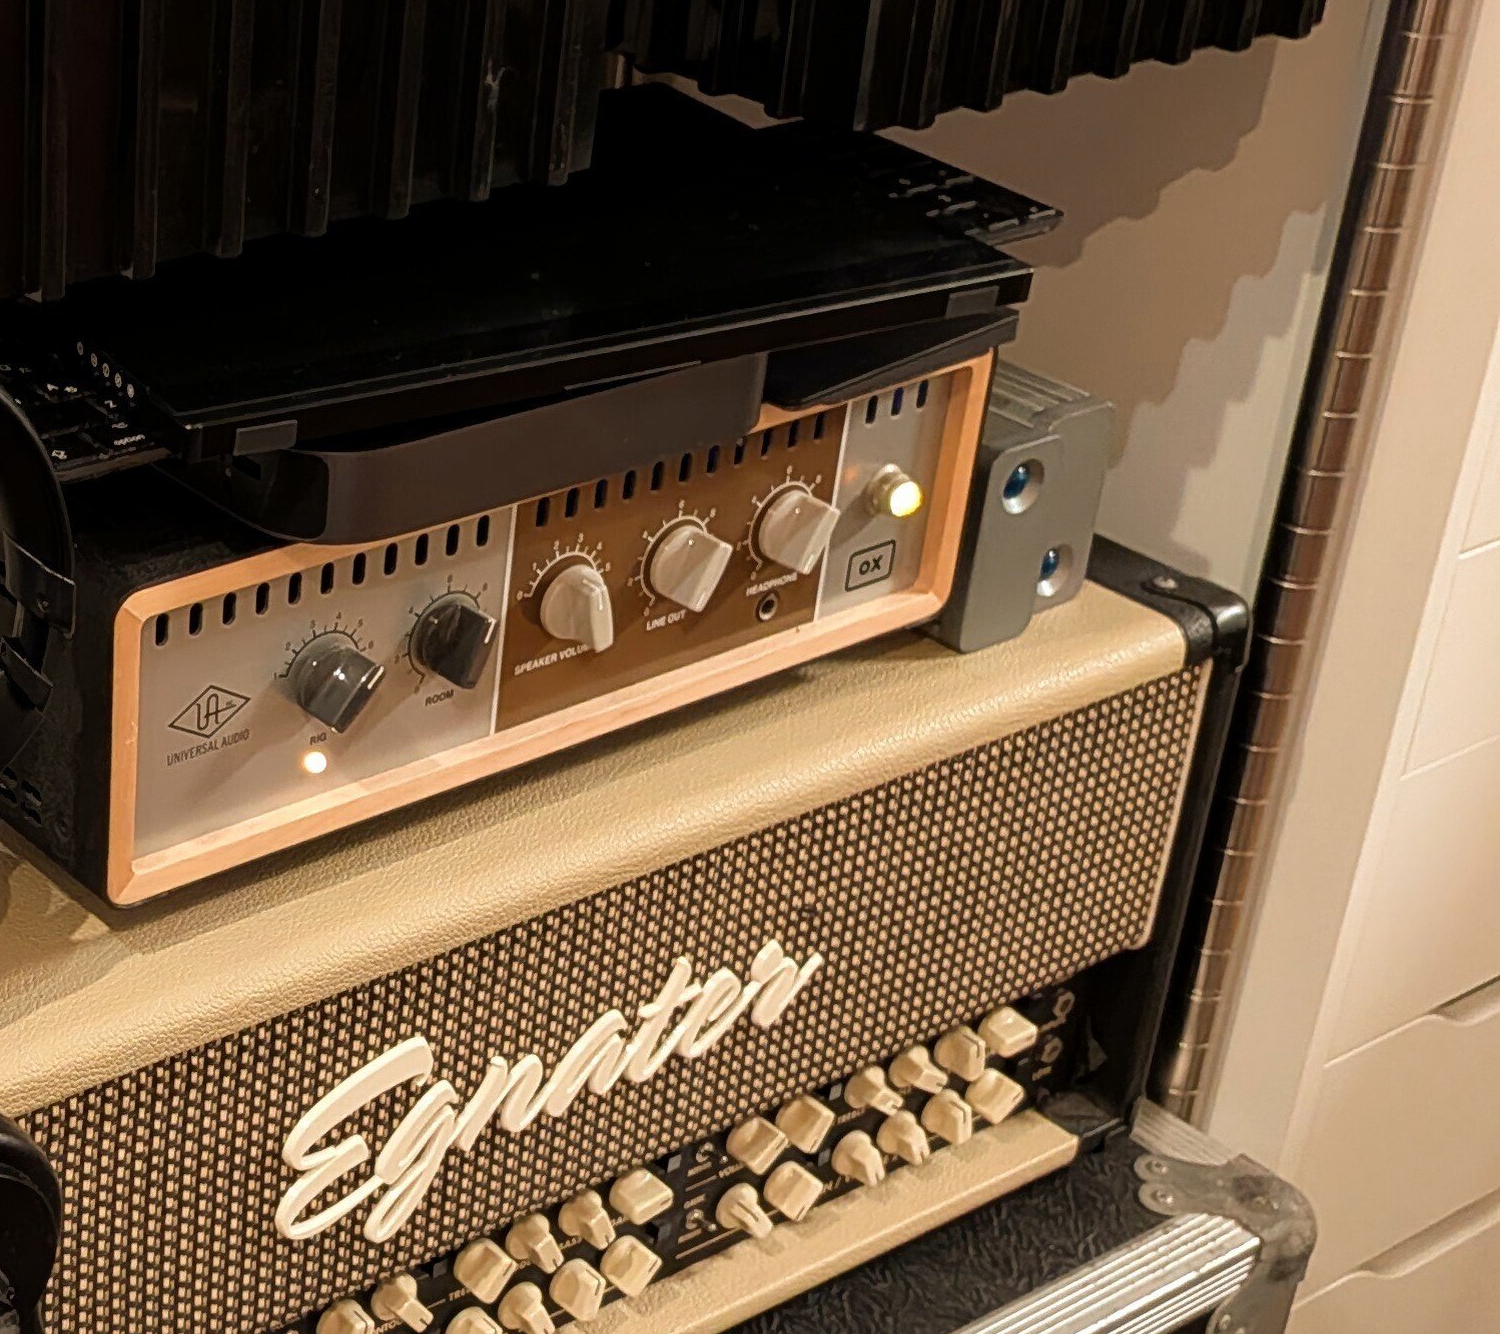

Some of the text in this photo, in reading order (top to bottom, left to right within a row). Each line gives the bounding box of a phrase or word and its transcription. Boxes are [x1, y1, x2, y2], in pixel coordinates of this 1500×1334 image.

[645, 615, 667, 631] LINE
[514, 651, 558, 677] SPEAKER
[424, 688, 455, 706] ROOM
[166, 727, 250, 766] UNIVERSAL AUDIO
